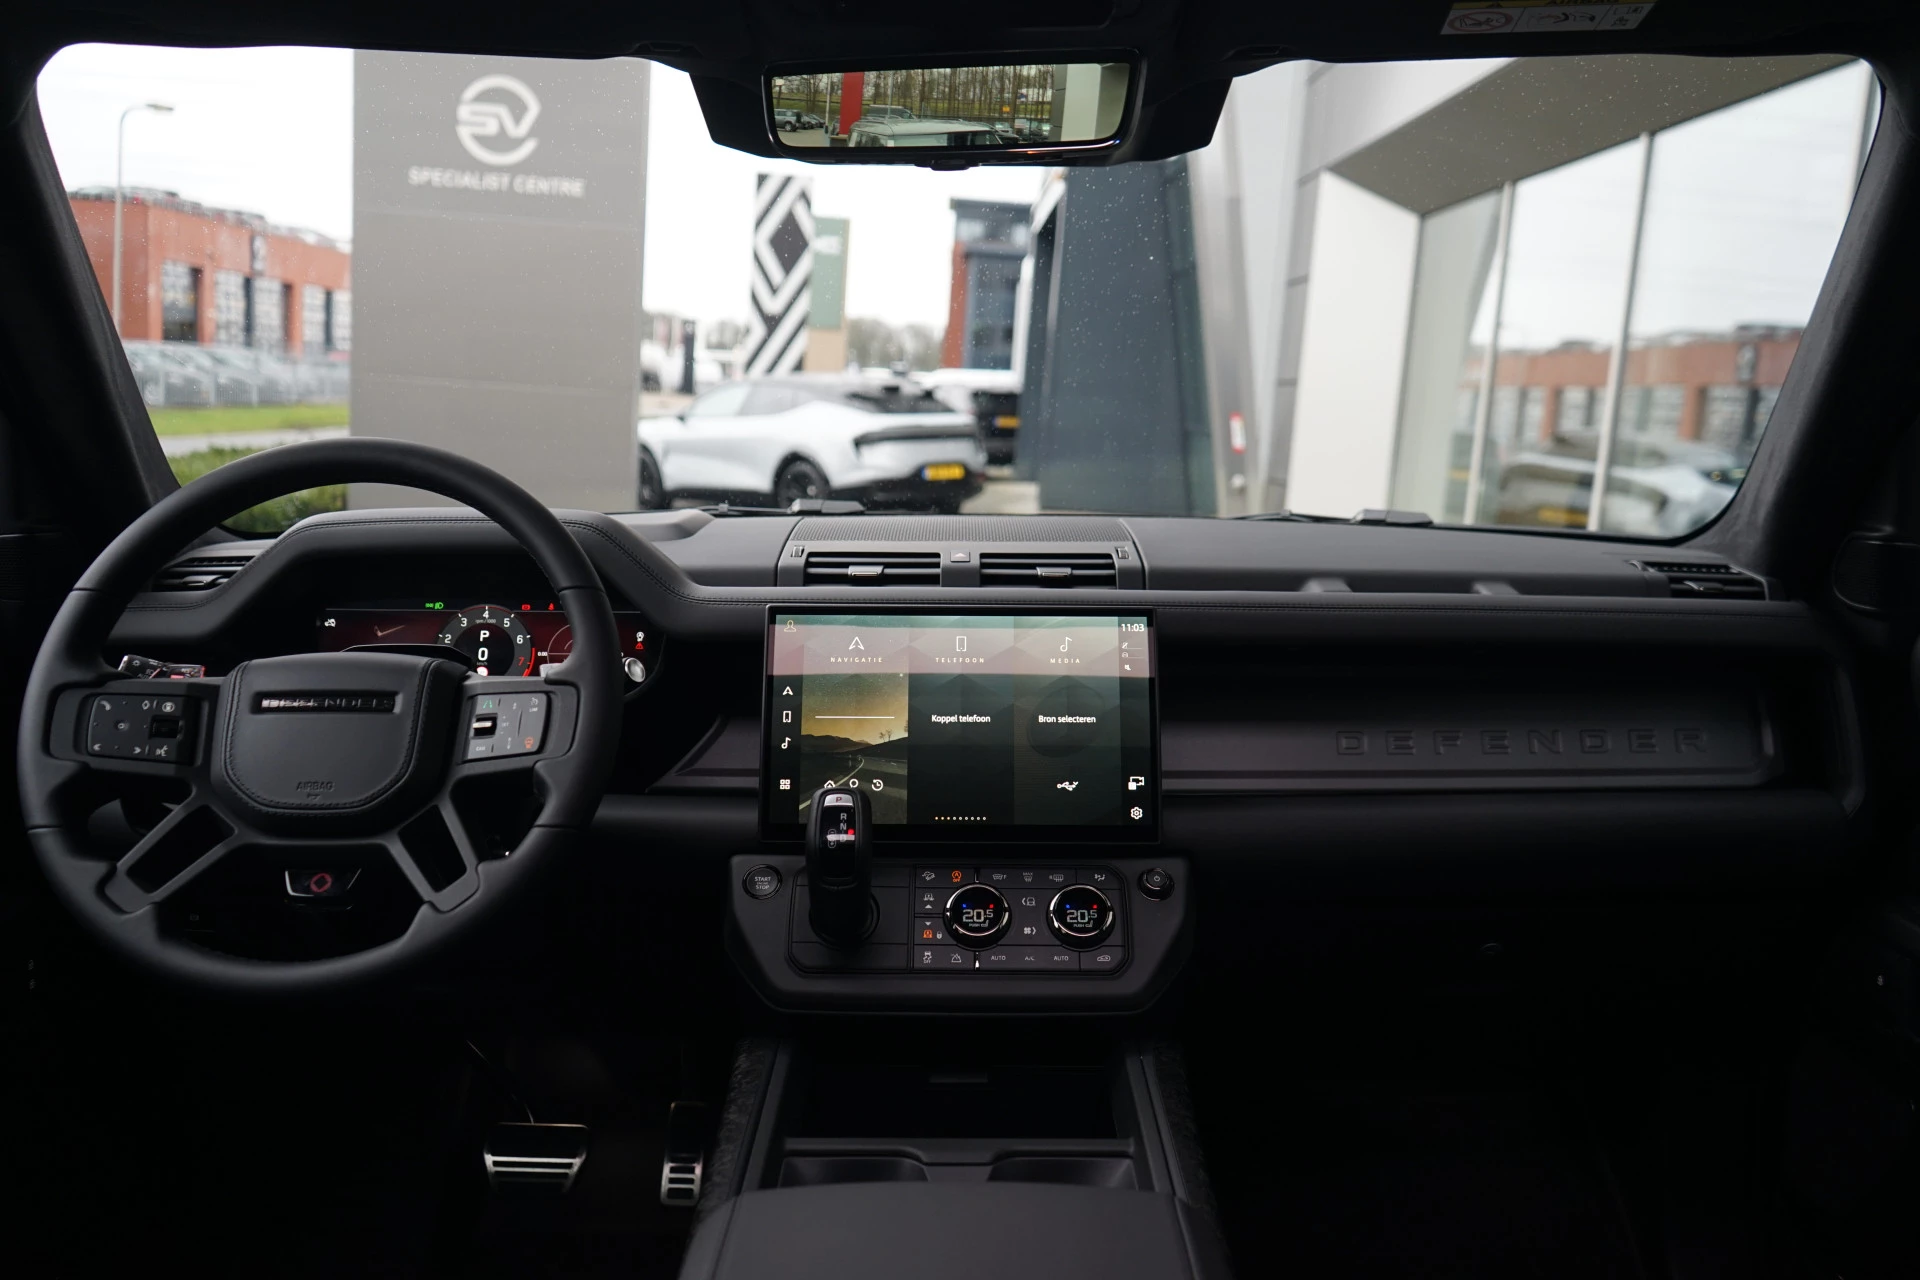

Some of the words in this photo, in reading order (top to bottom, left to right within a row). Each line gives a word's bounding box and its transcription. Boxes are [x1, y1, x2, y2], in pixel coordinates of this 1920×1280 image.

[408, 166, 511, 192] SPECIALIST
[512, 174, 587, 198] CENTRE
[483, 611, 489, 619] 4
[460, 618, 467, 627] 3
[503, 618, 510, 627] 5
[1121, 623, 1145, 632] 11:03
[444, 634, 452, 643] 2
[480, 630, 490, 642] P
[516, 635, 524, 644] 6
[478, 647, 488, 661] 0
[518, 656, 525, 666] 7
[931, 714, 958, 724] Koppel
[958, 714, 991, 723] telefoon
[1038, 715, 1057, 723] Bron
[1057, 715, 1097, 724] selecteren
[1336, 728, 1708, 756] DEFENDER
[296, 781, 335, 792] AIRBAG
[840, 812, 847, 820] R
[840, 822, 847, 830] N
[962, 909, 994, 922] 20.5
[1066, 909, 1098, 923] 20.5
